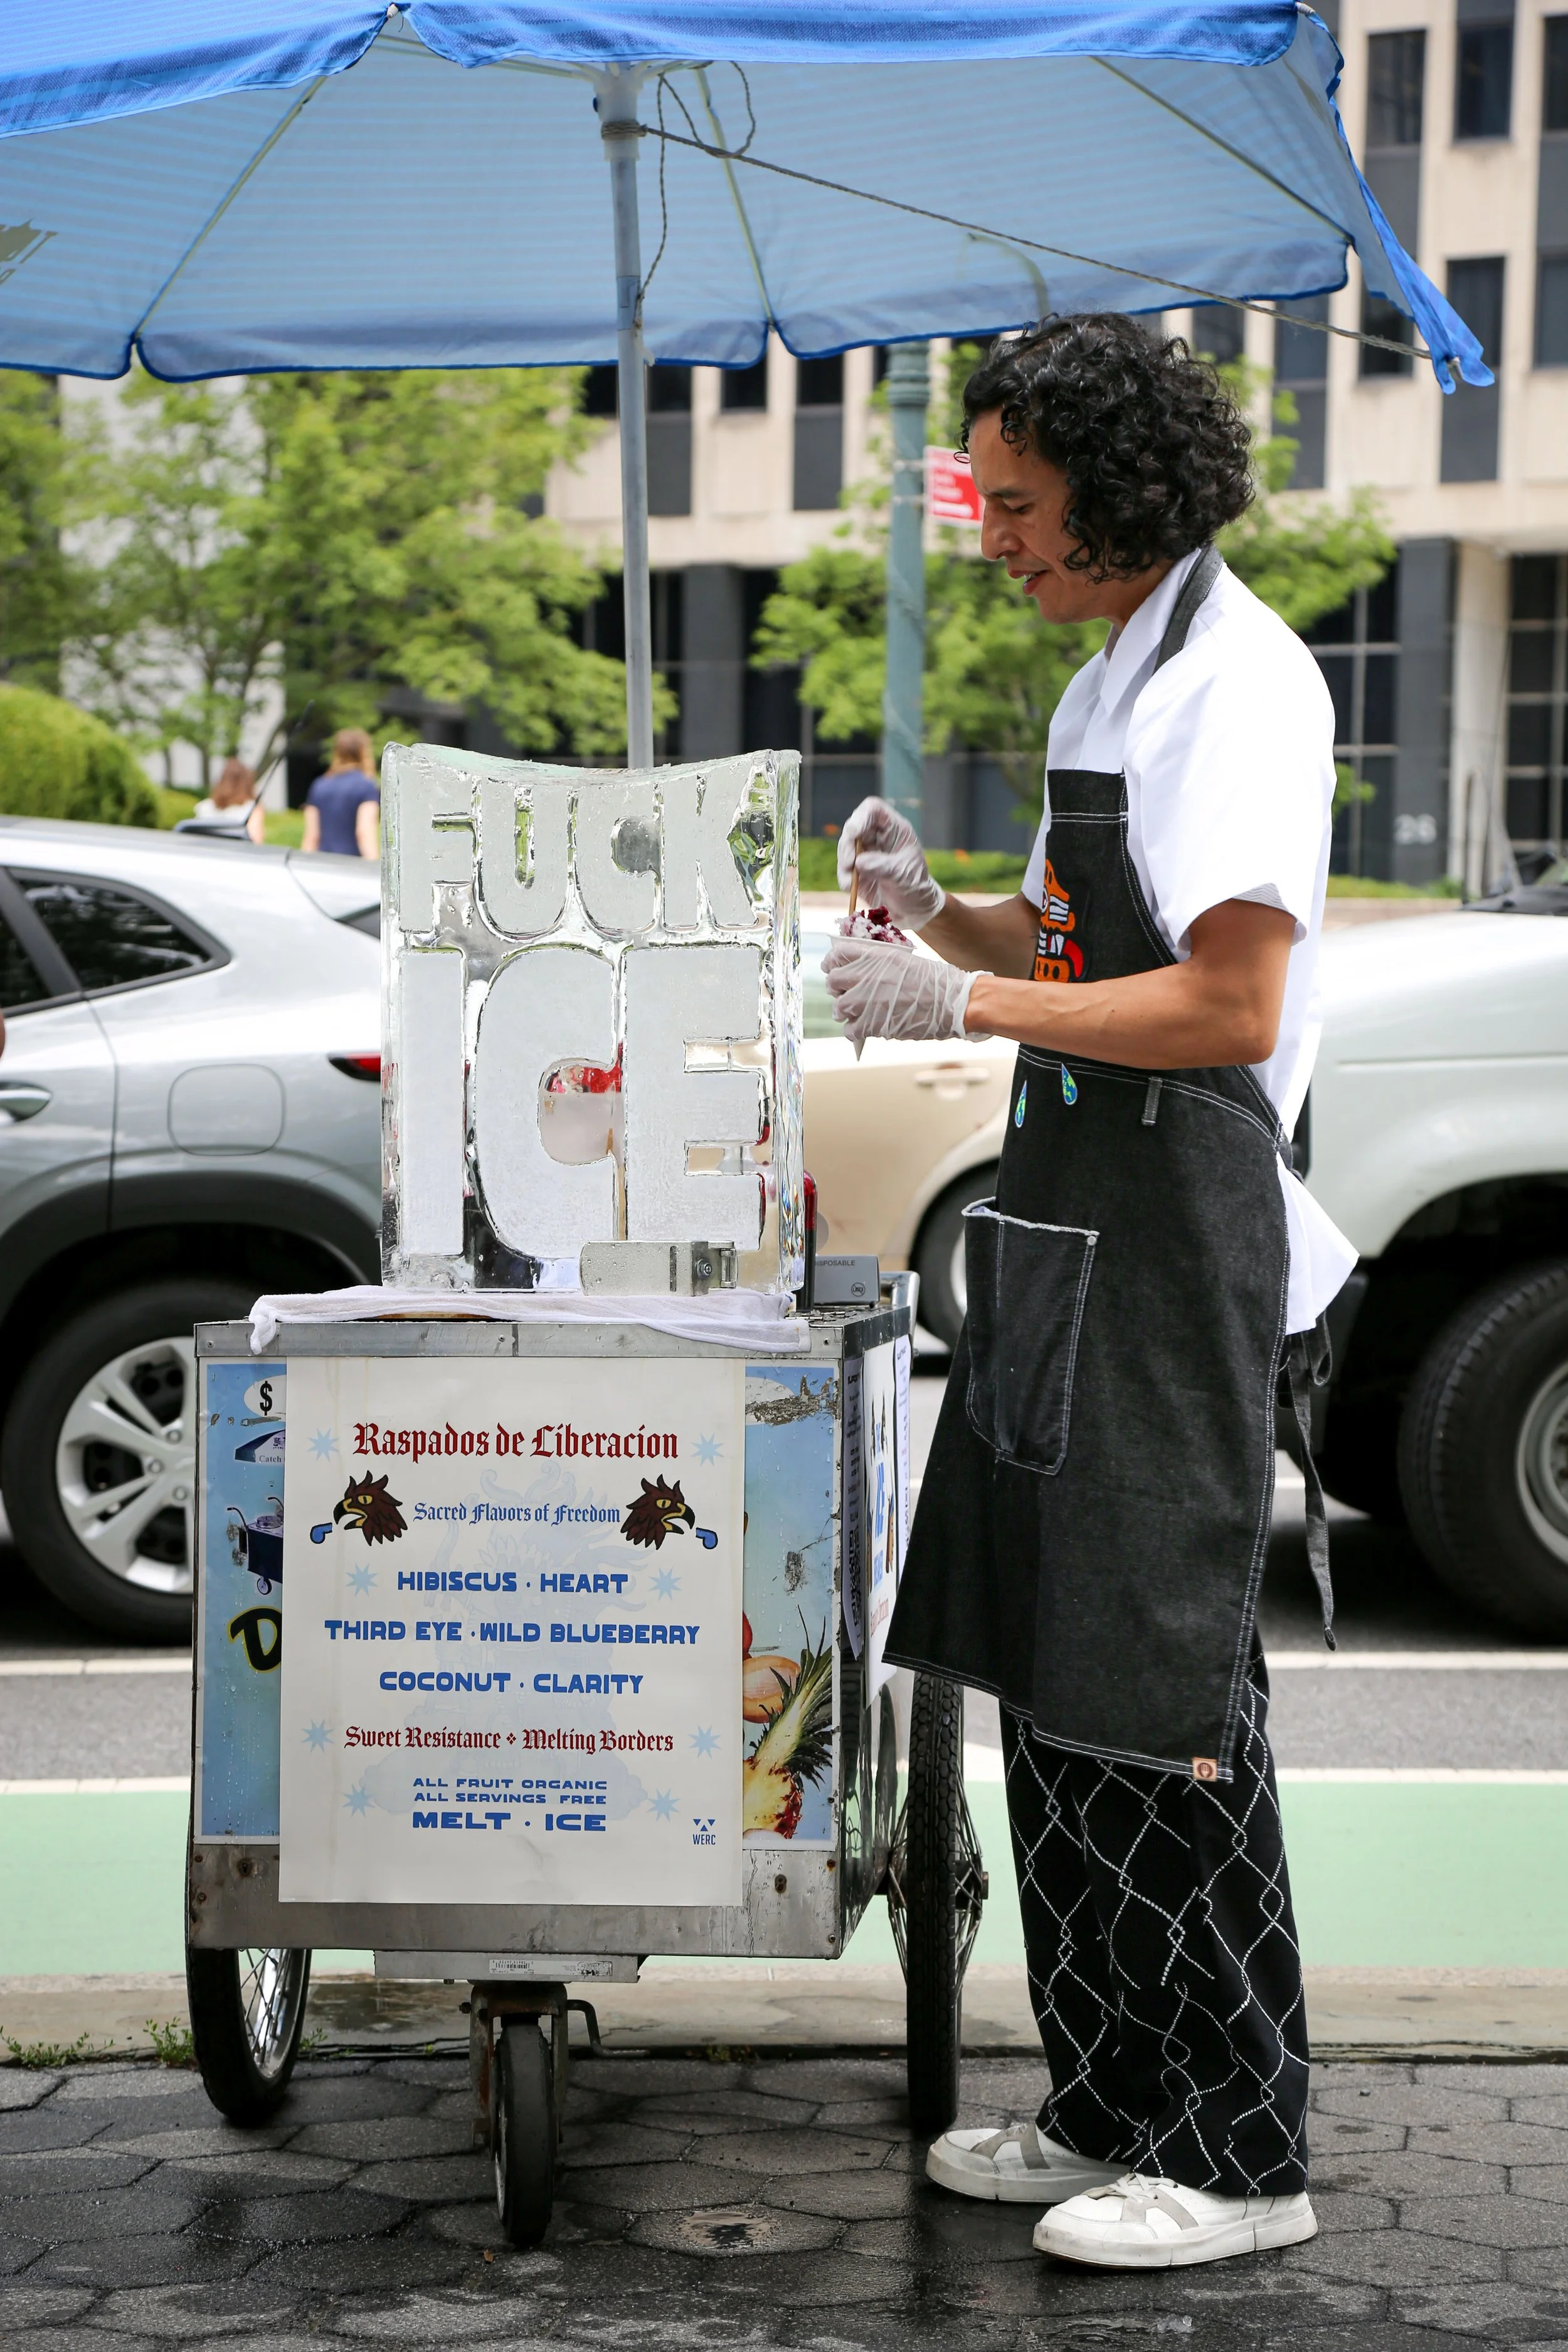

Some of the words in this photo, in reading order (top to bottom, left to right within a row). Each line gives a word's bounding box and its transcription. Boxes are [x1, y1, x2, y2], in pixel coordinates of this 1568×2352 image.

[398, 760, 761, 938] FUCK
[398, 945, 761, 1256] ICE
[352, 1422, 489, 1464] Raspados
[496, 1422, 524, 1456] de
[530, 1423, 678, 1458] Liberacion
[259, 1454, 282, 1463] Catch
[413, 1503, 466, 1521] Sacred
[469, 1503, 531, 1525] Flavors
[535, 1503, 549, 1522] of
[552, 1504, 620, 1525] Freedom
[398, 1571, 517, 1592] HIBISCUS
[541, 1574, 628, 1593] HEART
[325, 1620, 405, 1640] THIRD
[416, 1622, 462, 1641] EYE
[480, 1623, 540, 1642] WILD
[551, 1624, 699, 1644] BLUEBERRY
[380, 1671, 511, 1692] COCONUT
[534, 1674, 643, 1694] CLARITY
[344, 1726, 401, 1749] Sweet
[405, 1727, 501, 1749] Resistance
[522, 1728, 596, 1755] Melting
[599, 1729, 673, 1752] Borders
[413, 1778, 448, 1787] ALL
[457, 1779, 513, 1788] FRUIT
[522, 1780, 607, 1789] ORGANIC
[414, 1793, 448, 1801] ALL
[456, 1793, 546, 1803] SERVINGS
[560, 1795, 606, 1804] FREE
[413, 1812, 511, 1830] MELT
[546, 1814, 606, 1831] ICE
[692, 1834, 716, 1845] WERC
